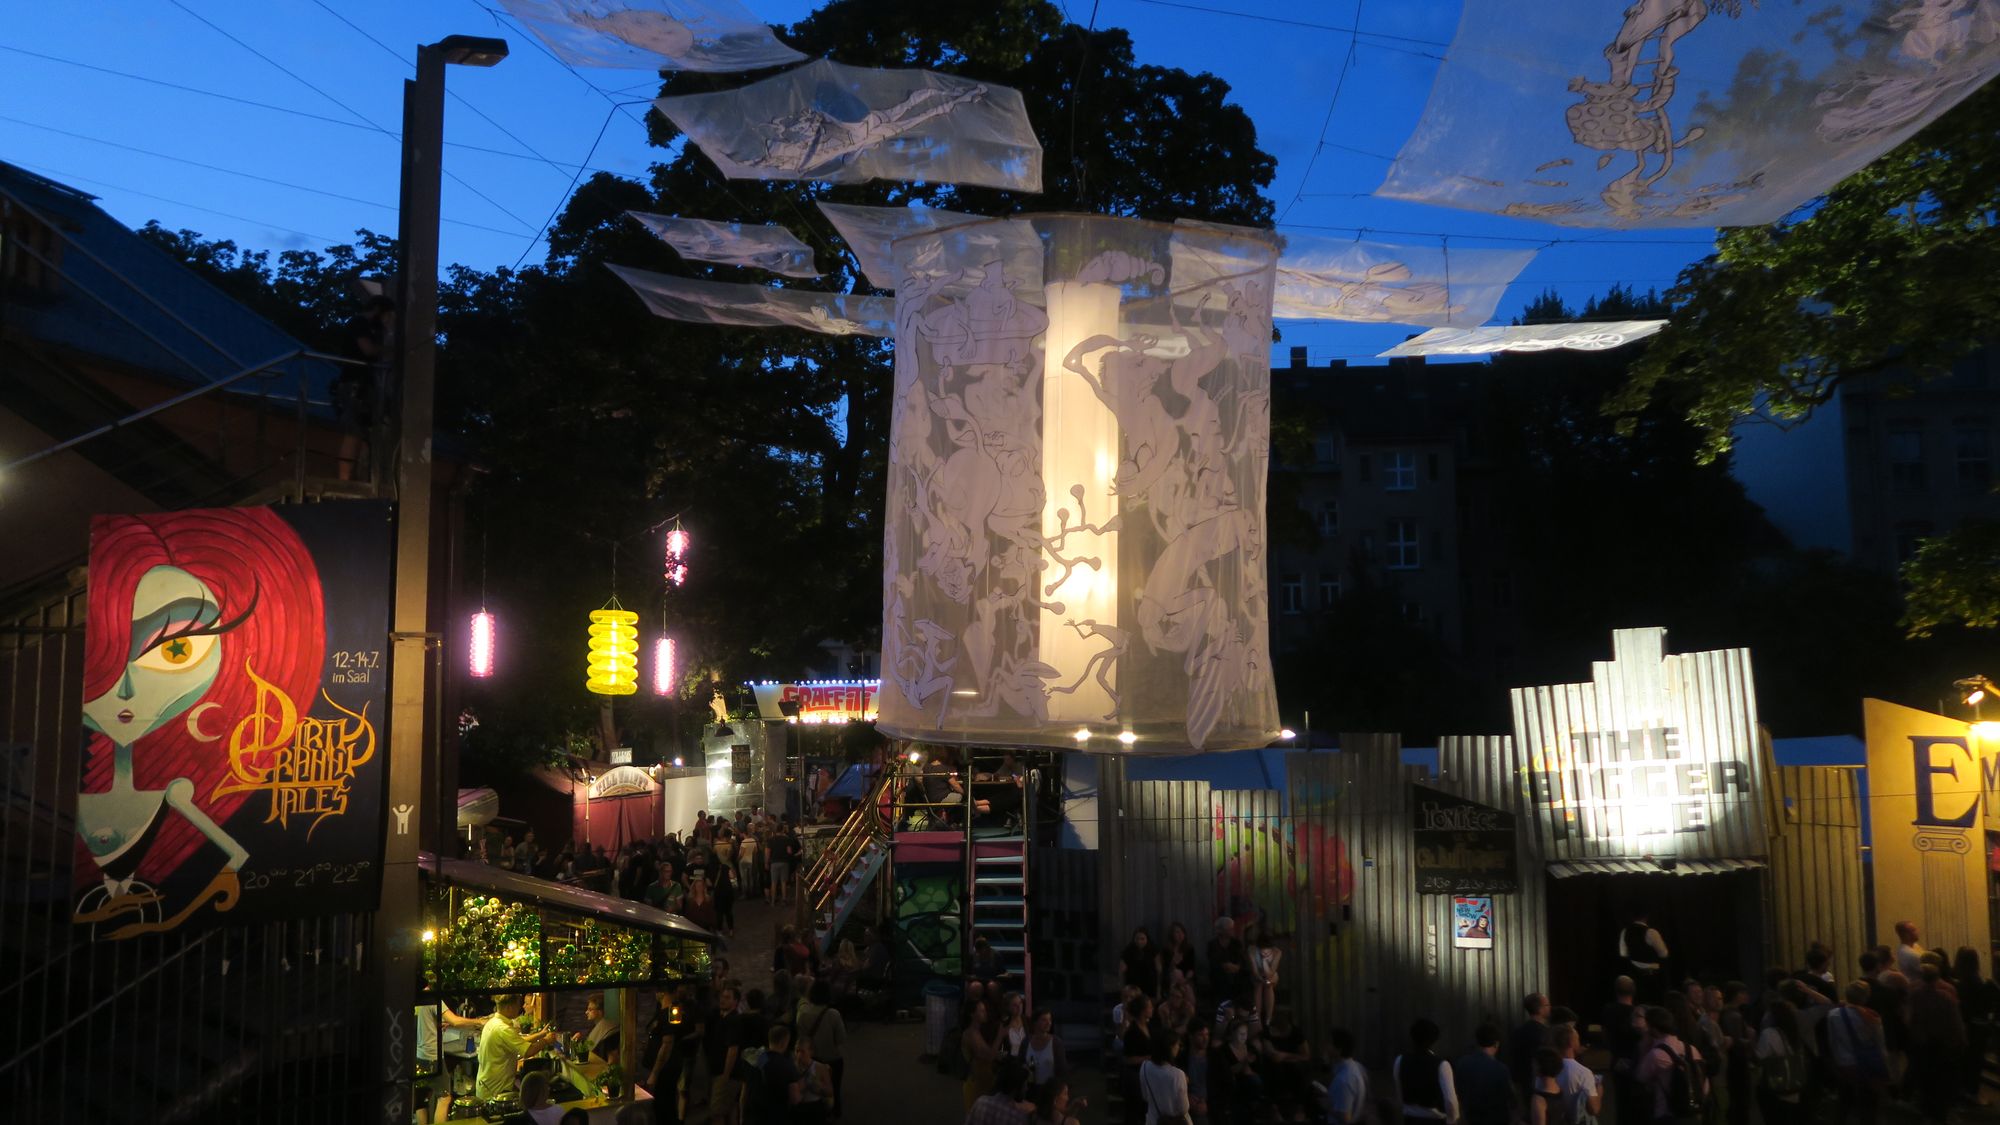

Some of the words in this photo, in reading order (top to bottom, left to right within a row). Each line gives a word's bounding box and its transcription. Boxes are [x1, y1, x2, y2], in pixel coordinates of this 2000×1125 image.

[332, 671, 345, 683] im
[347, 669, 370, 683] Saal
[1571, 727, 1680, 764] THE
[1530, 761, 1750, 803] BIGGER
